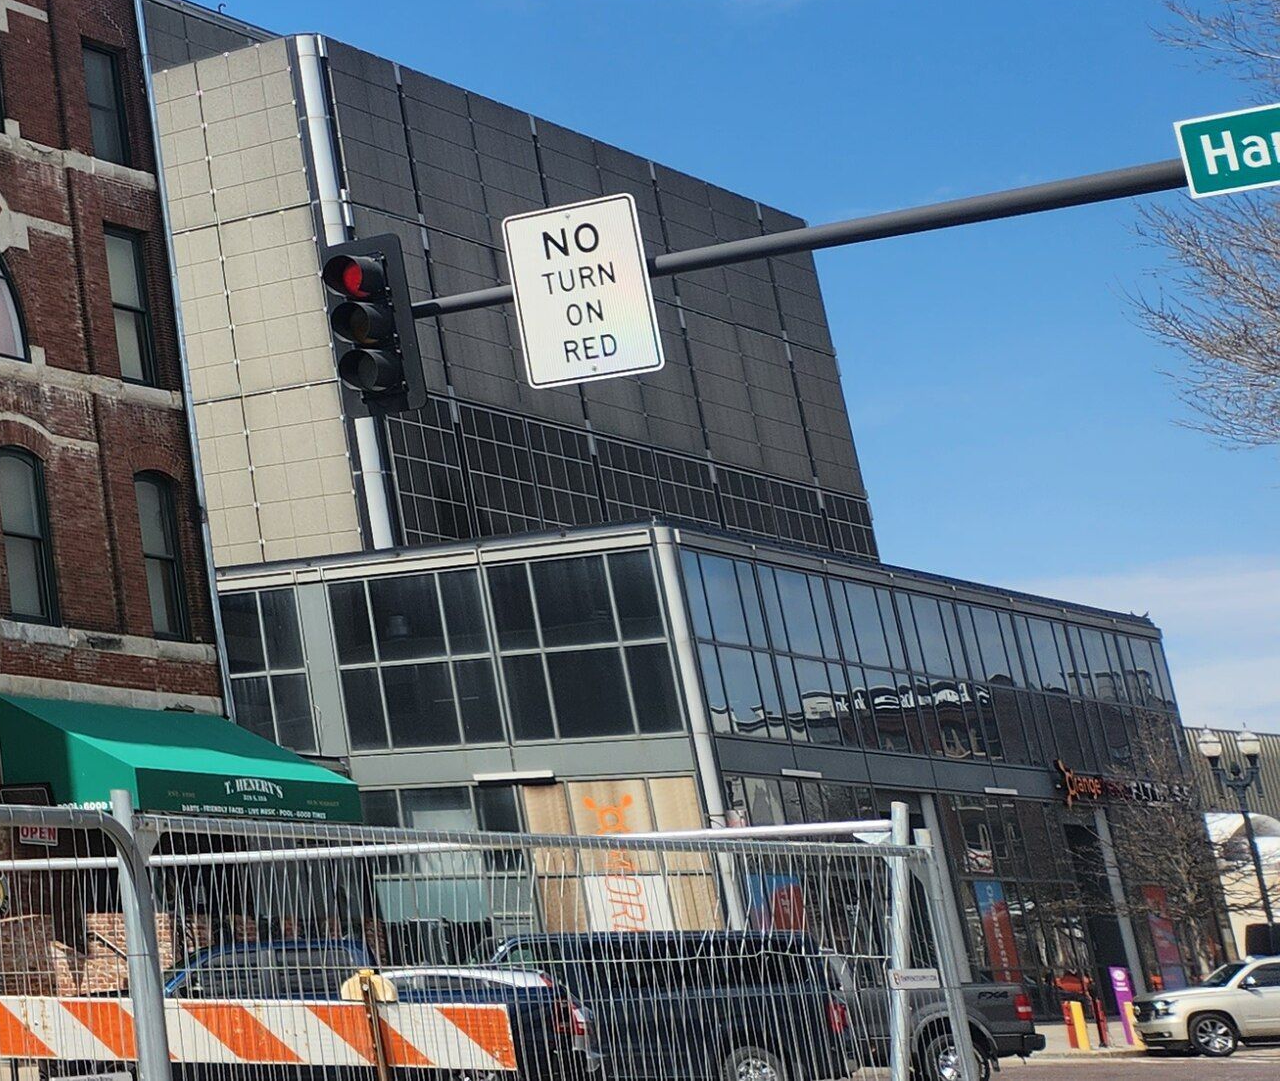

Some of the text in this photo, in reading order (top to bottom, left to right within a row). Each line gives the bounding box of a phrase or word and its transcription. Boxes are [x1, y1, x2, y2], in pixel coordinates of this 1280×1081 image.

[542, 223, 599, 260] NO
[541, 262, 616, 295] TURN
[566, 299, 604, 326] ON
[563, 334, 617, 363] RED
[20, 826, 56, 840] OPEN
[977, 990, 1010, 1001] FX4
